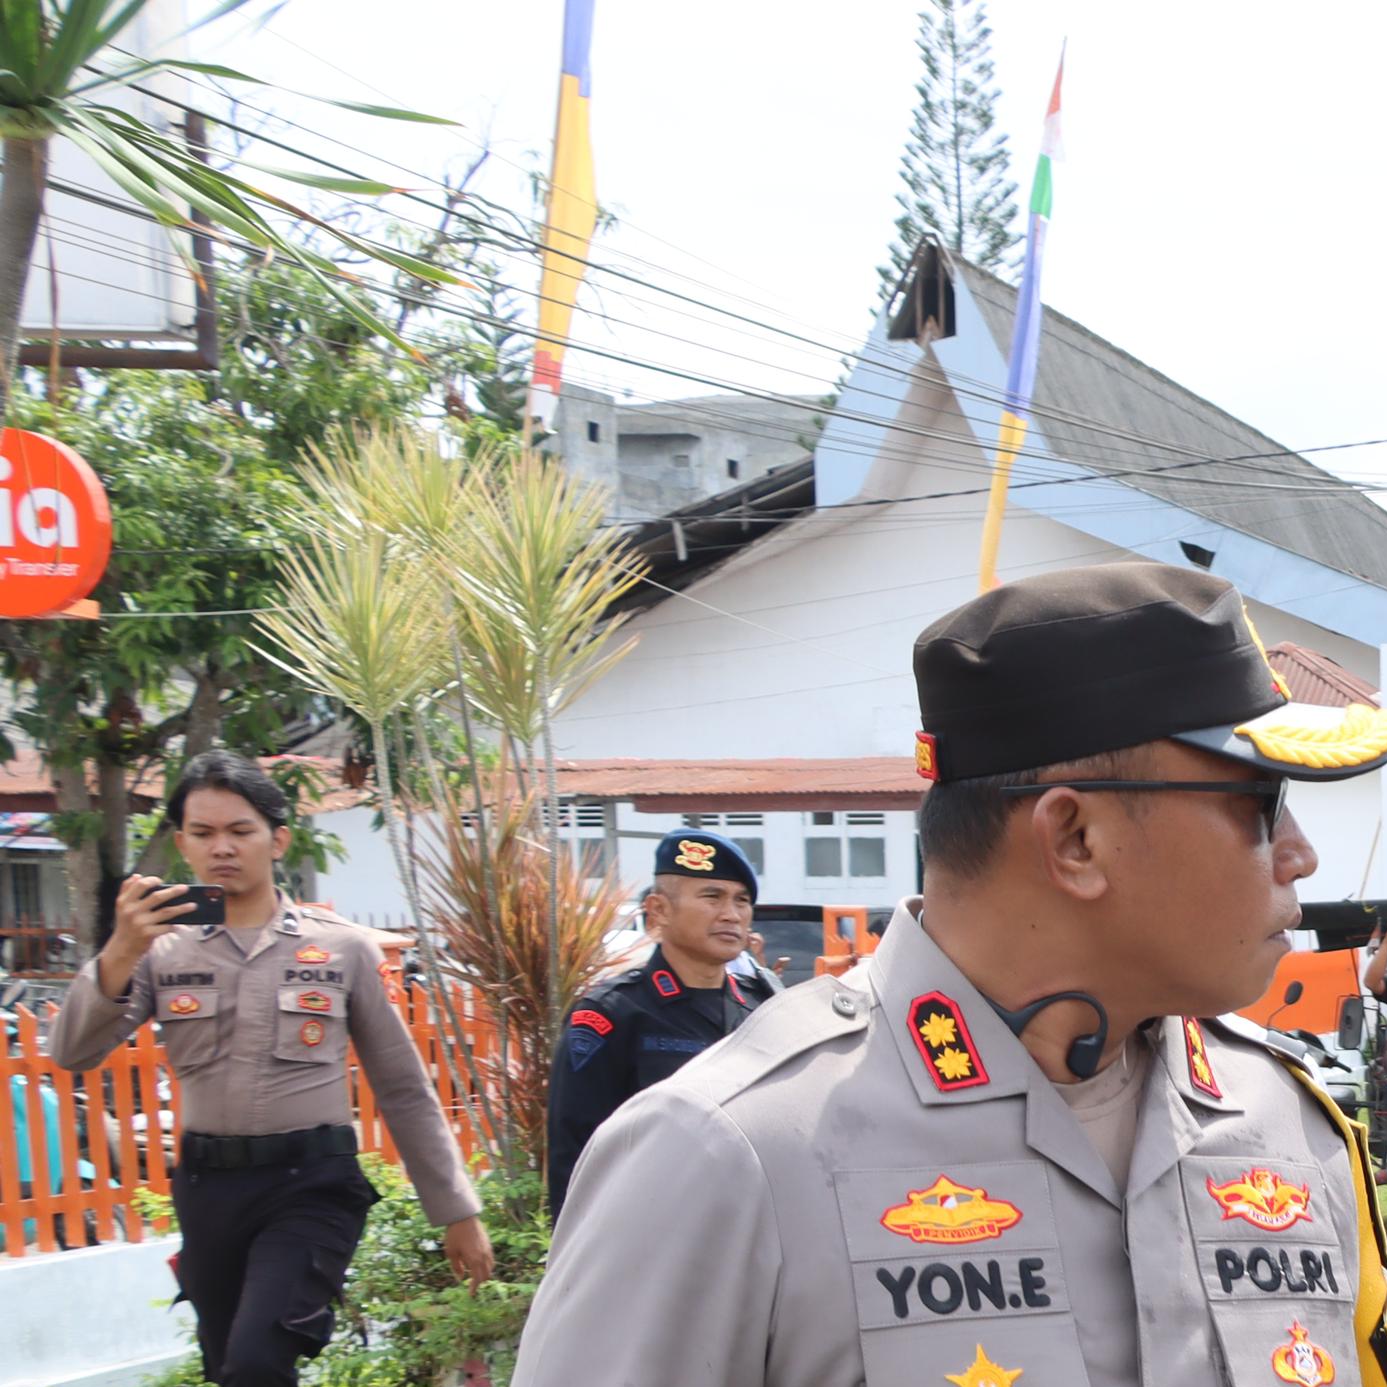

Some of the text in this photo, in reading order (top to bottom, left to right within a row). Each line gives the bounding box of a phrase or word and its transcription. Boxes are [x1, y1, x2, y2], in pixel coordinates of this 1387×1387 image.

[285, 969, 343, 984] POLRI
[876, 1257, 1051, 1319] YON.E
[1215, 1246, 1339, 1294] POLRI
